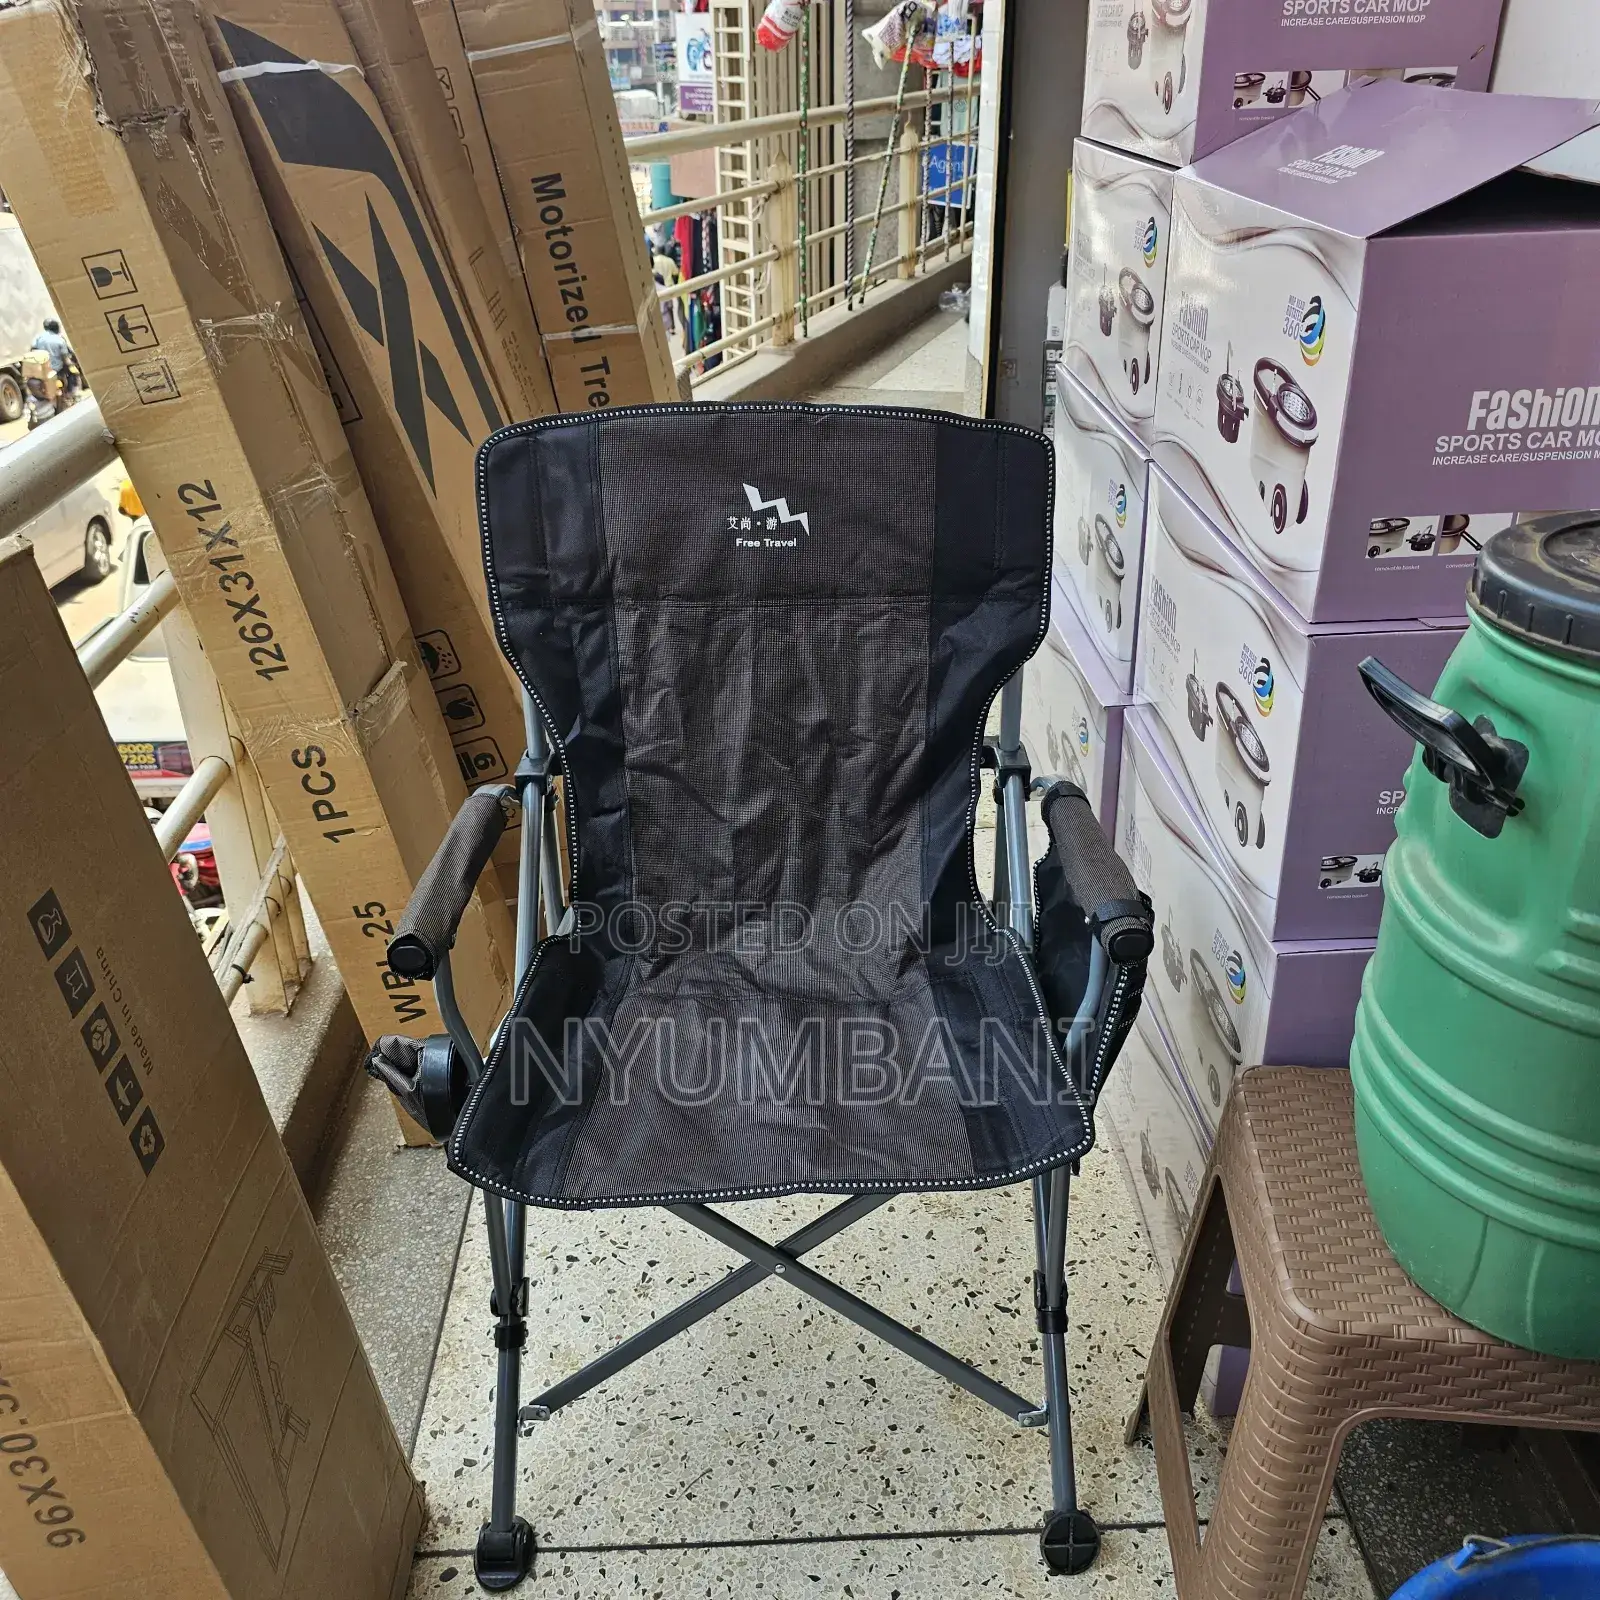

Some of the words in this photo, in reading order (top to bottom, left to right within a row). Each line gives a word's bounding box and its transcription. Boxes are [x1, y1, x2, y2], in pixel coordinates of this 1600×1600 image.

[1282, 0, 1350, 16] SPORTS
[1353, 0, 1389, 14] CAR
[1392, 0, 1430, 13] MOP
[1281, 17, 1324, 27] INCREASE
[1325, 15, 1406, 26] CARE/SUSPENSION
[1406, 14, 1426, 23] MOP
[929, 154, 964, 174] Agnt
[531, 172, 602, 344] Motorized
[1435, 433, 1522, 453] SPORTS
[1526, 431, 1573, 449] CAR
[1432, 454, 1487, 466] INCREASE
[1489, 450, 1592, 463] CARE/SUSPENSION
[736, 538, 760, 547] Free
[764, 537, 796, 547] Travel
[177, 479, 290, 682] 126X31X12
[291, 744, 356, 844] 1PCS
[96, 946, 122, 1003] China
[121, 1003, 133, 1027] in
[131, 1025, 154, 1076] Made
